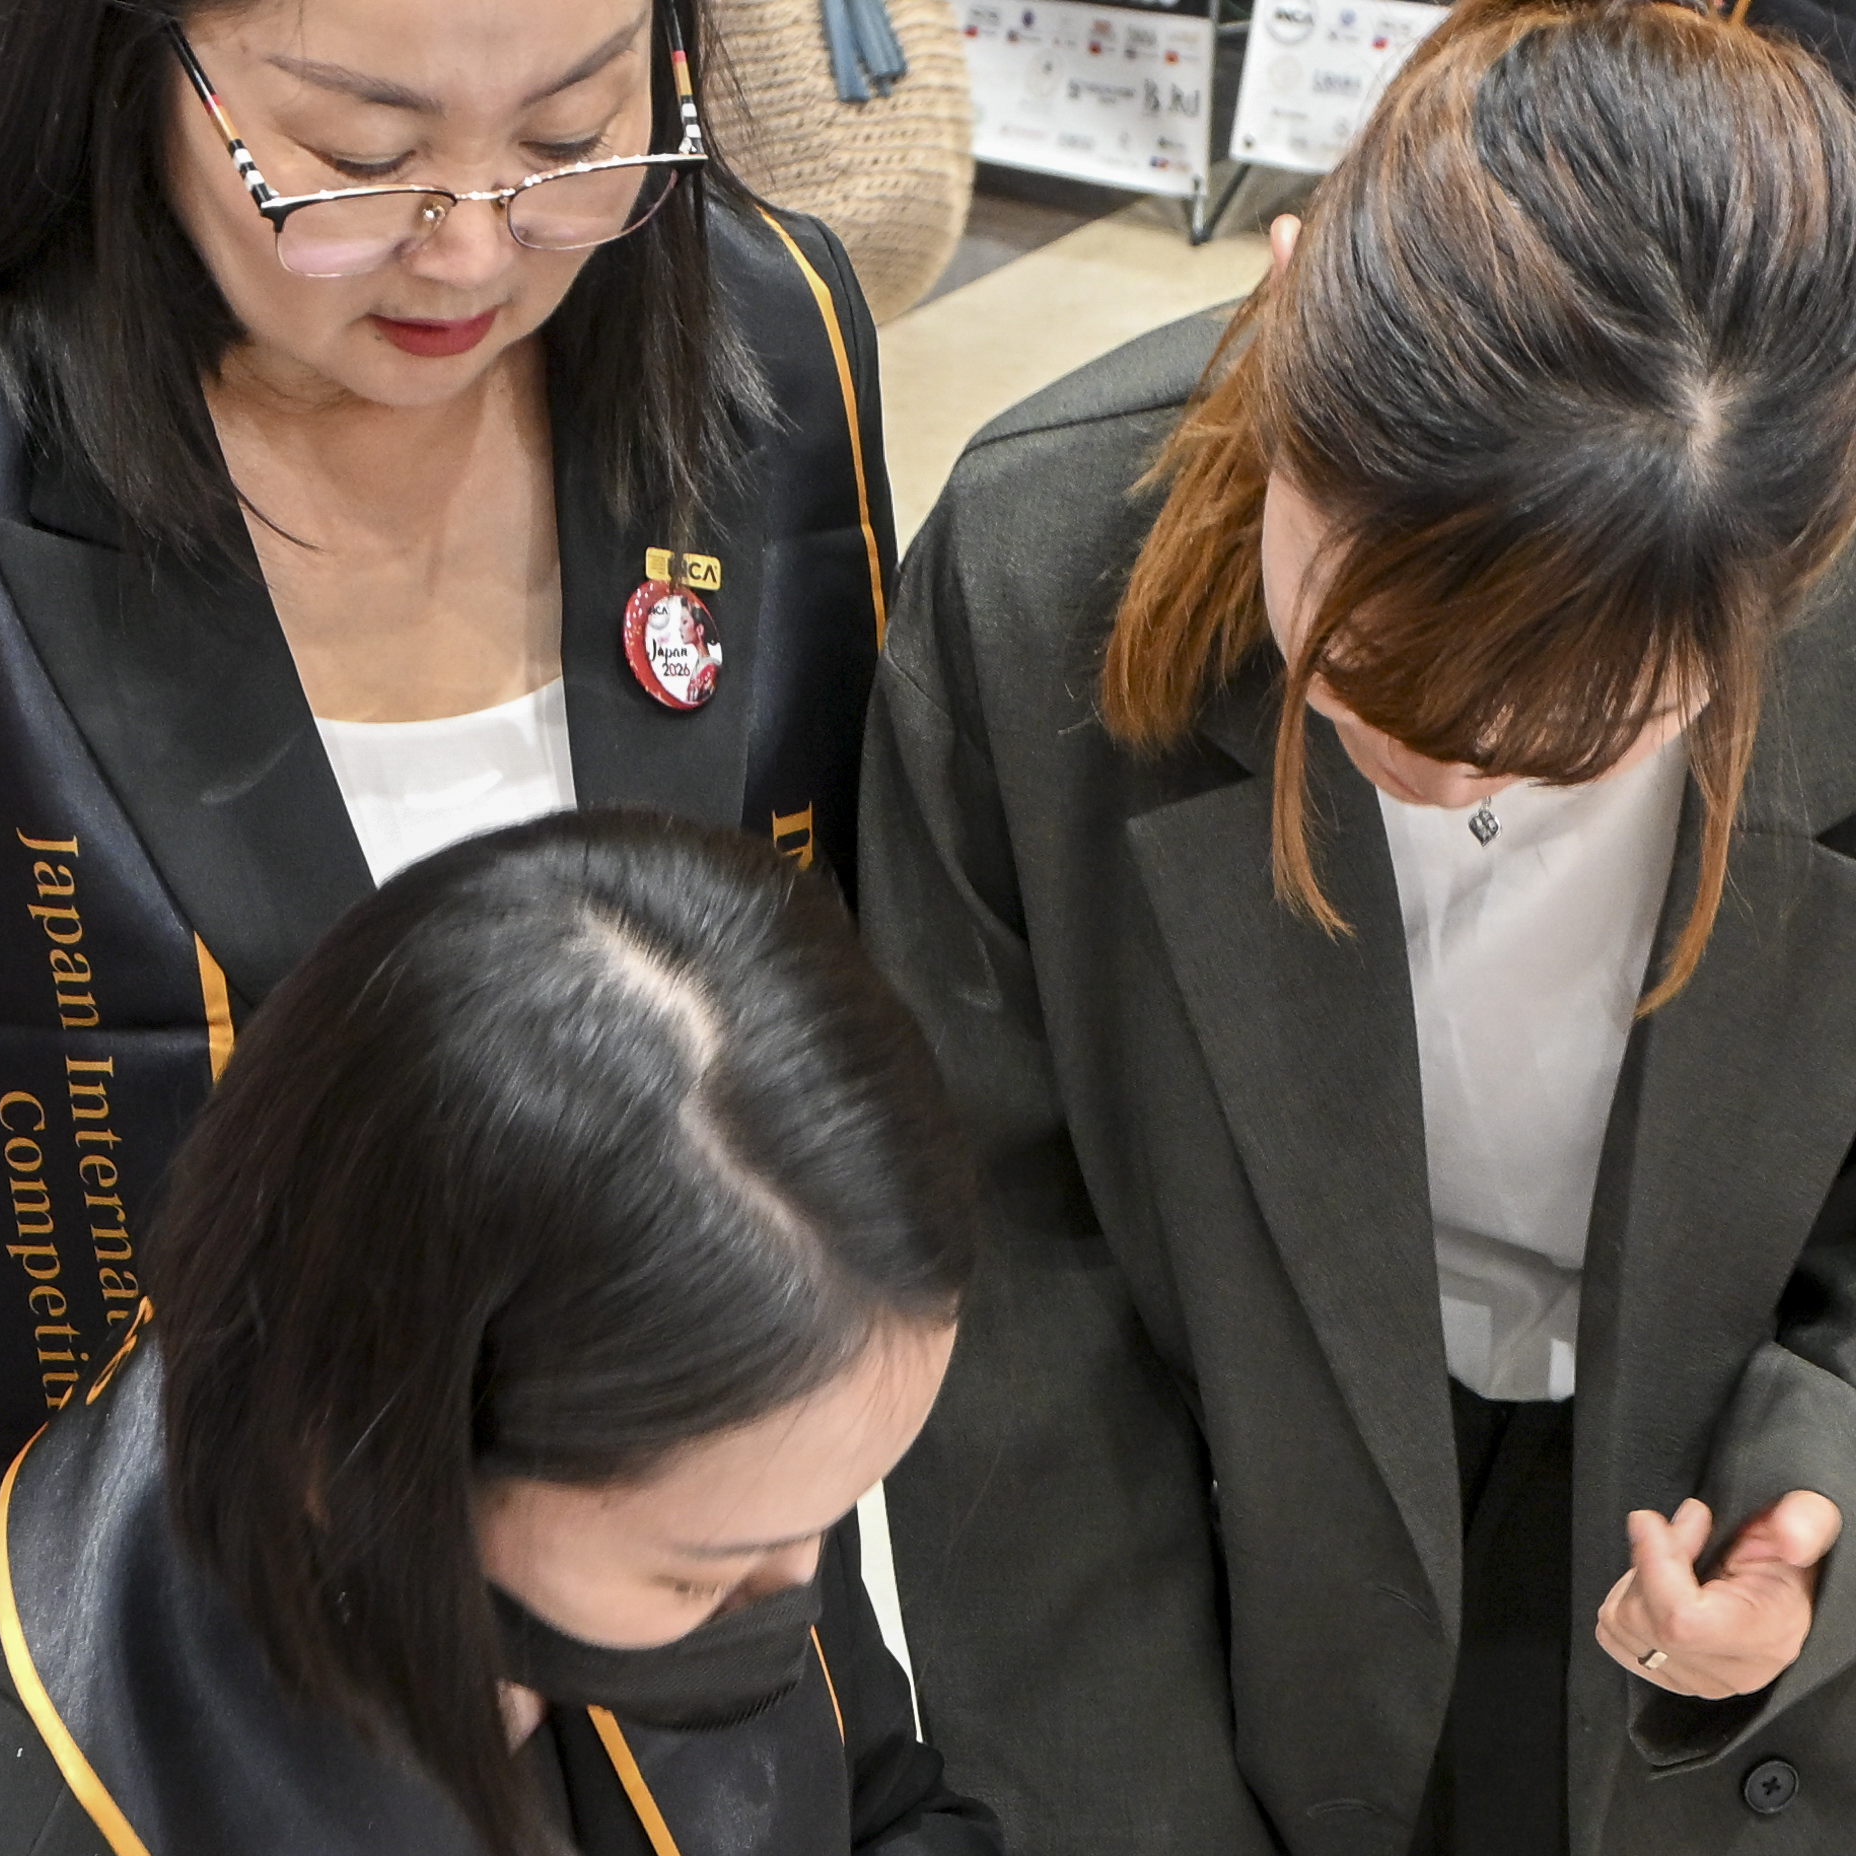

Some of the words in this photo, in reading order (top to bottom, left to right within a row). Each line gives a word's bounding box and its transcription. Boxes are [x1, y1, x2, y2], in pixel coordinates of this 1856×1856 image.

[648, 638, 688, 663] Japan
[662, 663, 690, 677] 2026
[17, 828, 102, 1028] Japan
